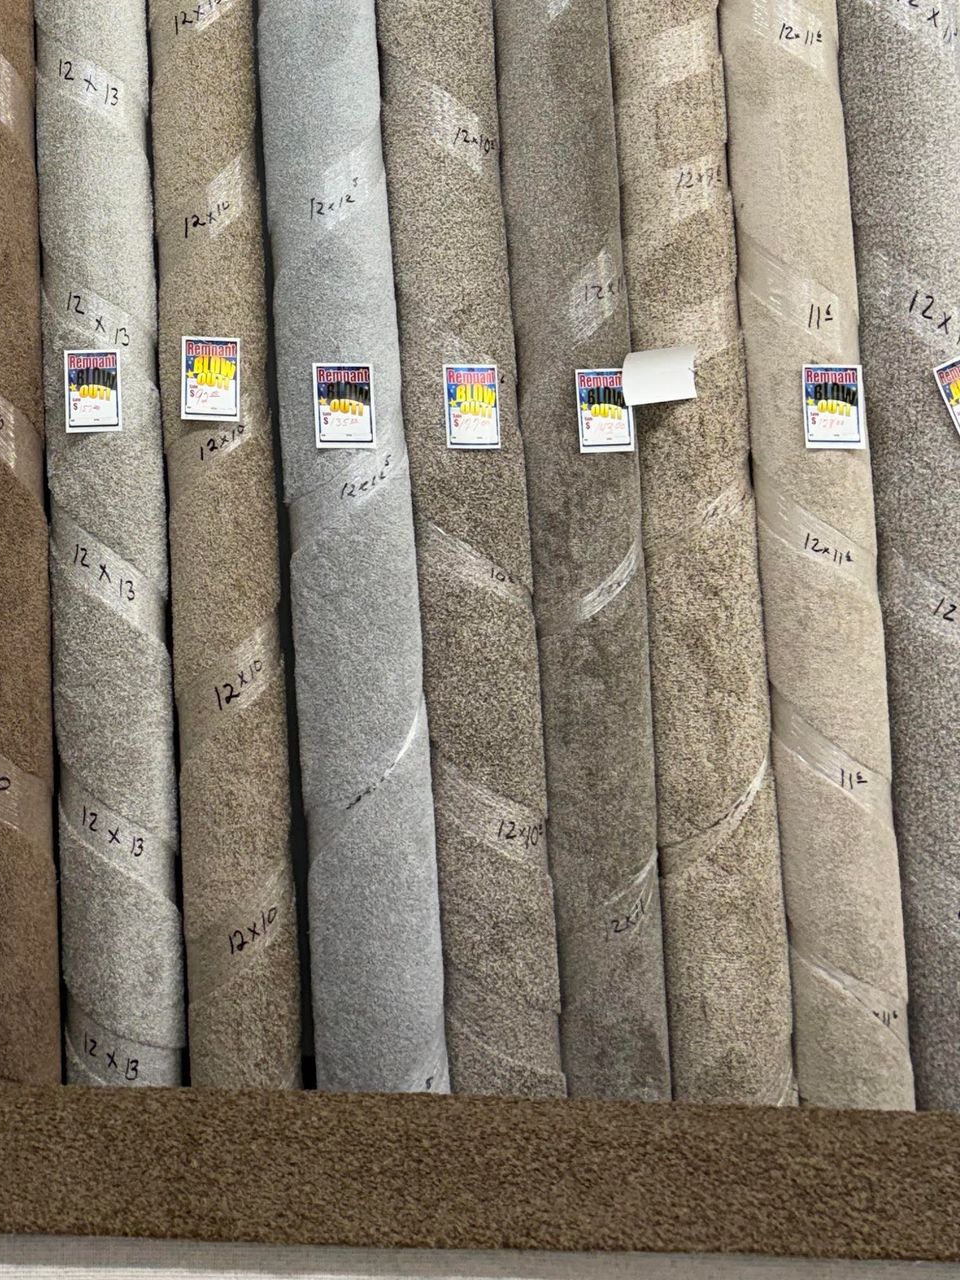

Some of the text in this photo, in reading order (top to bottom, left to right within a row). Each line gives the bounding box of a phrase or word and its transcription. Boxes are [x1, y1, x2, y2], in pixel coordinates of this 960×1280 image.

[187, 342, 237, 357] Remnant
[70, 355, 117, 370] Remnant
[194, 355, 236, 380] BLOW
[318, 368, 369, 383] Remnant
[448, 370, 495, 384] Remnant
[579, 374, 621, 388] Remnan
[806, 370, 856, 383] Remnant
[456, 383, 496, 407] BLOW
